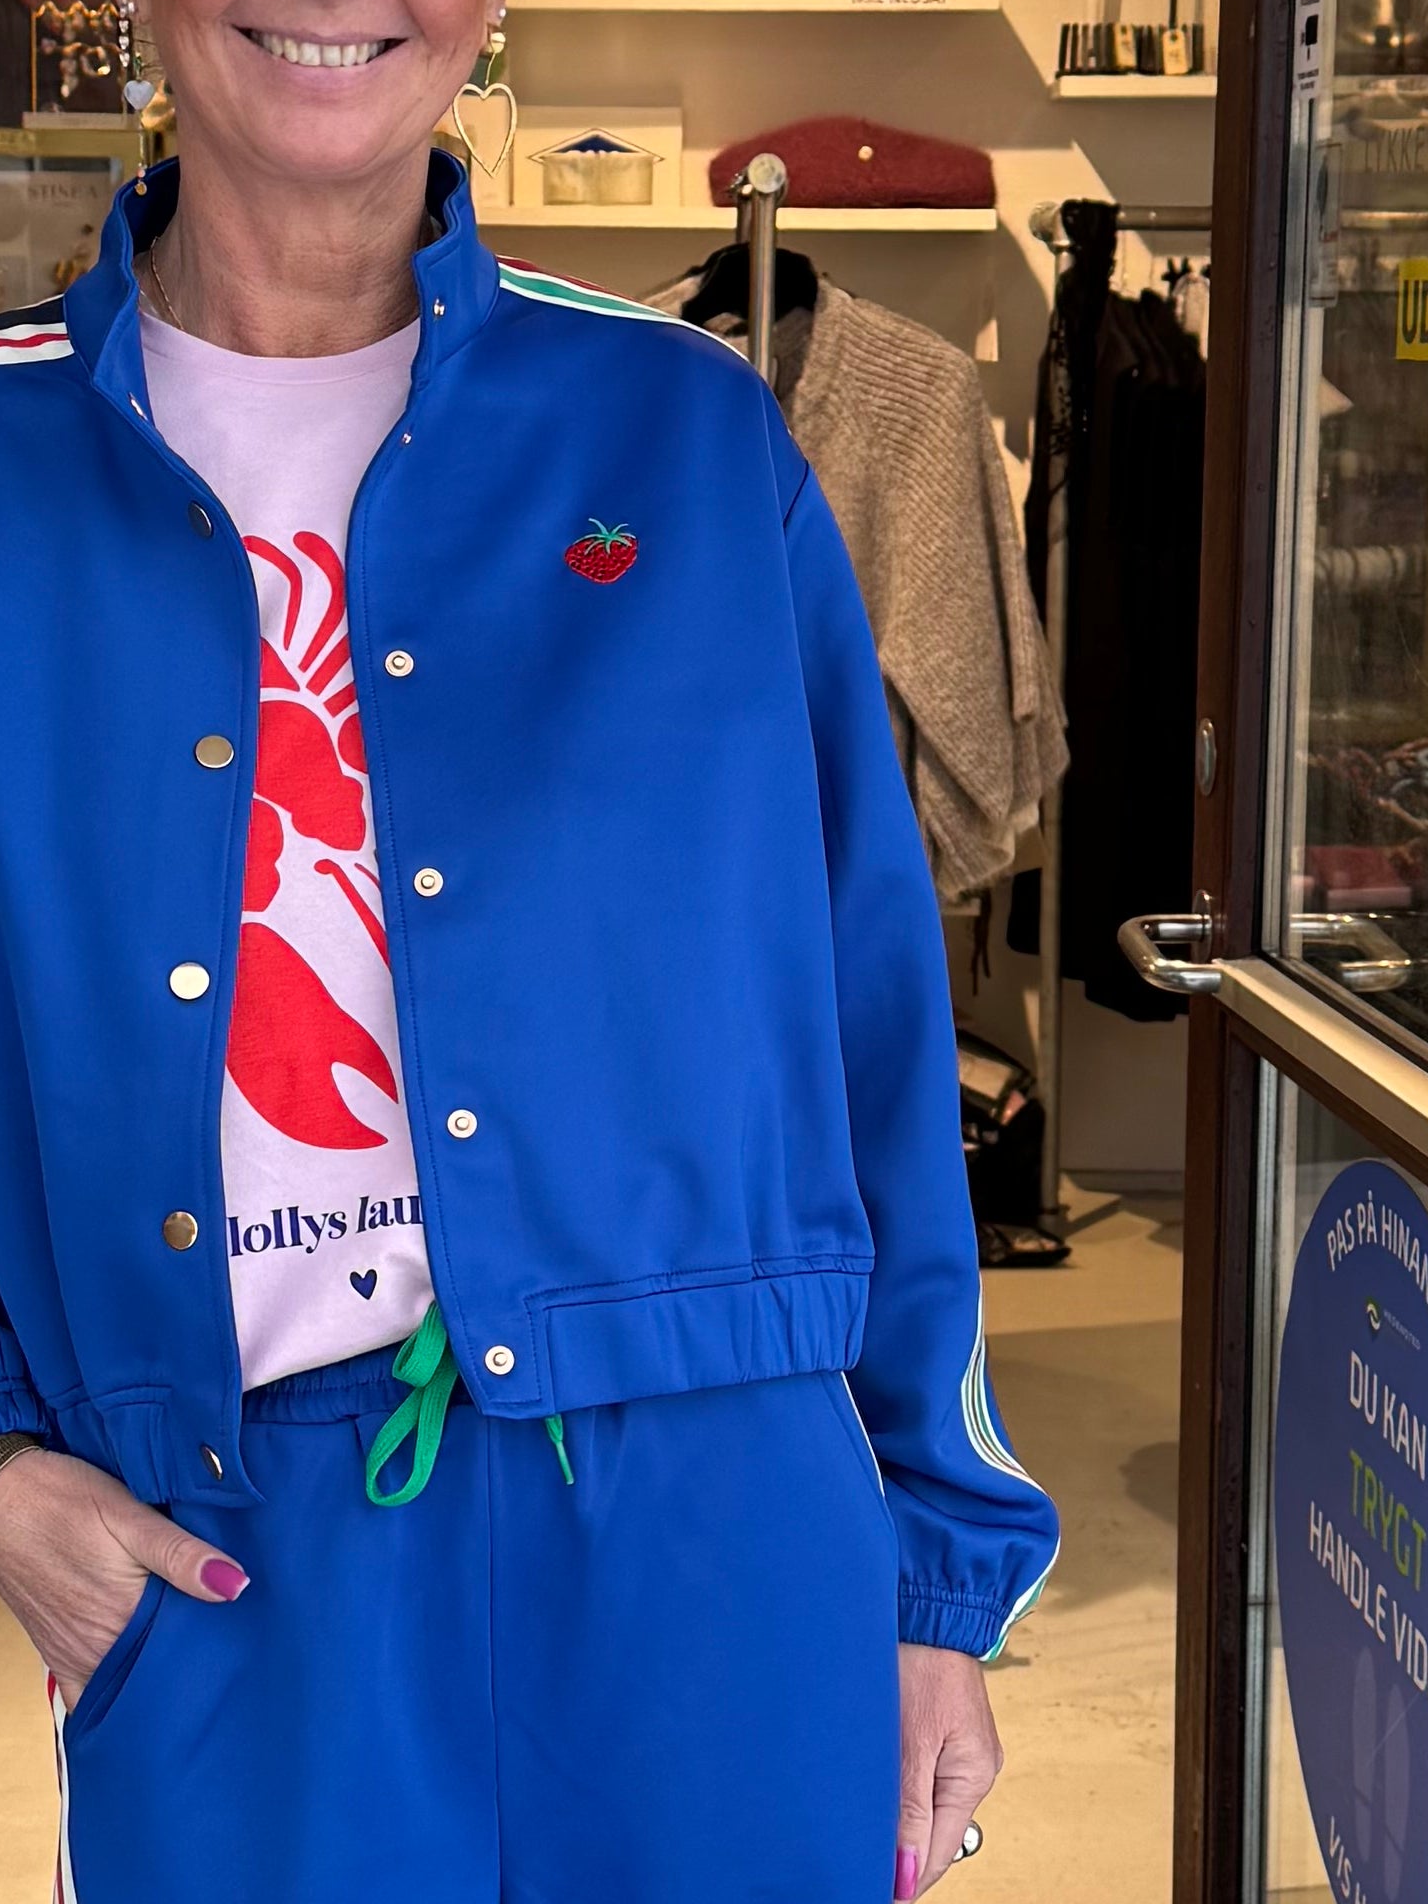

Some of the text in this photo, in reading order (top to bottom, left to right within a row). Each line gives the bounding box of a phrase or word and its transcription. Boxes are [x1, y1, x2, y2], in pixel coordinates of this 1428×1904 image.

[227, 1205, 348, 1258] lollys
[1326, 1207, 1356, 1273] PAS
[1356, 1189, 1378, 1246] PÅ
[1349, 1349, 1428, 1482] DU KAN
[1308, 1499, 1388, 1645] HANDLE
[1348, 1447, 1428, 1593] TRYGT
[1328, 1815, 1353, 1899] VIS
